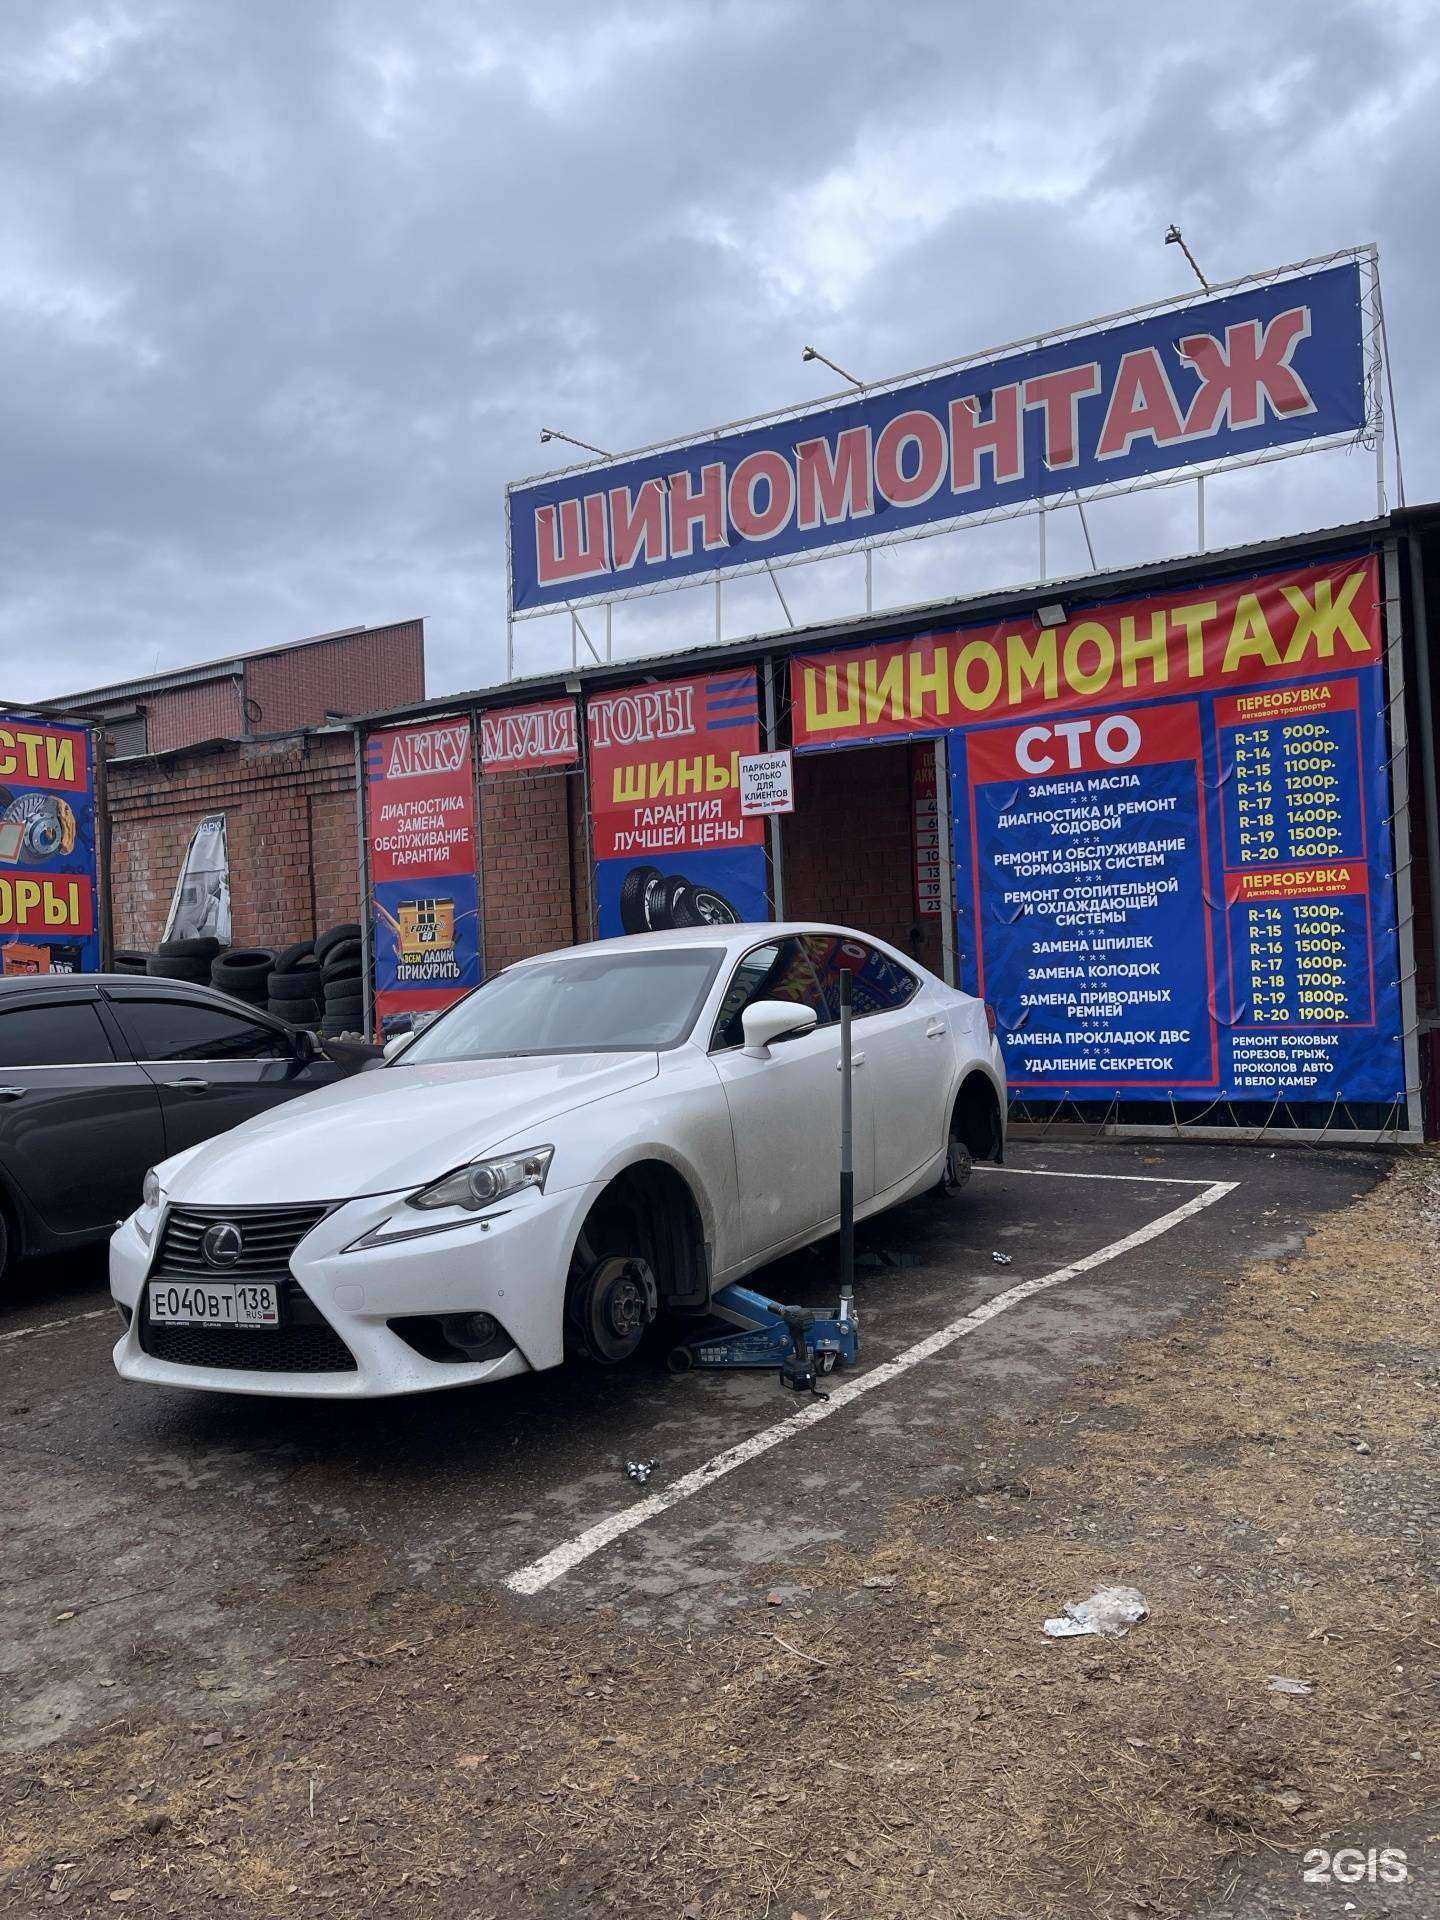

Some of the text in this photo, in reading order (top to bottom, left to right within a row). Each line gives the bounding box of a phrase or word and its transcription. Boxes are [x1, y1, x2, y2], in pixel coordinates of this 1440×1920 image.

[535, 306, 1317, 587] ШИНОМОНТАЖ
[803, 572, 1371, 732] ШИНОМОНТАЖ
[1236, 686, 1331, 711] ПЕРЕОБУВКА
[1280, 702, 1326, 715] транспорта
[1235, 724, 1330, 745] R-13 900р.
[1015, 715, 1141, 774] СТО
[1236, 740, 1339, 762] R-14 1000р.
[743, 760, 787, 773] ПАРКОВКА
[1237, 758, 1336, 779] R-15 1100р.
[612, 750, 740, 803] ШИНЫ
[749, 771, 782, 782] ТОЛЬКО
[757, 781, 774, 791] ДЛЯ
[1238, 774, 1339, 796] R-16 1200р.
[745, 789, 788, 801] КЛИЕНТОВ
[1028, 775, 1140, 798] ЗАМЕНА МАСЛА
[380, 796, 464, 822] ДИАГНОСТИКА
[1239, 791, 1340, 812] R-17 1300р.
[634, 799, 723, 828] ГАРАНТИЯ
[998, 798, 1177, 829] ДИАГНОСТИКА И РЕМОНТ
[1239, 809, 1342, 829] R-18 1400р.
[397, 814, 445, 833] ЗАМЕНА
[1051, 814, 1122, 835] ХОДОВОЙ
[374, 827, 469, 851] ОБСЛУЖИВАНИЕ
[613, 820, 744, 851] ЛУЧШЕЙ ЦЕНЫ
[1240, 825, 1342, 845] R-19 1500р.
[392, 847, 450, 866] ГАРАНТИЯ
[994, 838, 1186, 866] РЕМОНТ И ОБСЛУЖИВАНИЕ
[1241, 842, 1343, 862] R-20 1600р.
[1014, 854, 1164, 877] ТОРМОЗНЫХ СИСТЕМ
[1242, 868, 1351, 889] ПЕРЕОБУВКА
[1004, 877, 1179, 904] РЕМОНТ ОТОПИТЕЛЬНОЙ
[1284, 885, 1324, 896] грузовых
[1024, 894, 1158, 915] И ОХЛАЖДАЮЩЕЙ
[1249, 904, 1344, 921] R-14 1300р.
[1055, 911, 1126, 926] СИСТЕМЫ
[1249, 922, 1345, 938] R-15 1400р.
[1032, 936, 1153, 954] ЗАМЕНА ШПИЛЕК
[1250, 939, 1346, 955] R-16 1500р.
[403, 950, 454, 964] ВСЕМ ДАДИМ
[1251, 956, 1347, 972] R-17 1600р.
[397, 962, 460, 980] ПРИКУРИТЬ
[1028, 962, 1160, 980] ЗАМЕНА КОЛОДОК
[1252, 973, 1346, 988] R-18 1700р.
[1020, 989, 1171, 1006] ЗАМЕНА ПРИВОДНЫХ
[1253, 990, 1348, 1005] R-19 1800р.
[1067, 1002, 1123, 1018] РЕМНЕЙ
[1254, 1007, 1349, 1022] R-20 1900р.
[1007, 1030, 1190, 1045] ЗАМЕНА ПРОКЛАДОК ДВС
[1232, 1035, 1339, 1046] РЕМОНТ БОКОВЫХ
[1233, 1049, 1330, 1060] ПОРЕЗОВ, ГРЫЖ,
[1024, 1058, 1173, 1072] УДАЛЕНИЕ СЕКРЕТОК
[1233, 1063, 1334, 1073] ПРОКОЛОВ АВТО
[1234, 1076, 1318, 1086] И ВЕЛО КАМЕР
[238, 1288, 271, 1311] 138
[246, 1310, 263, 1320] RUS
